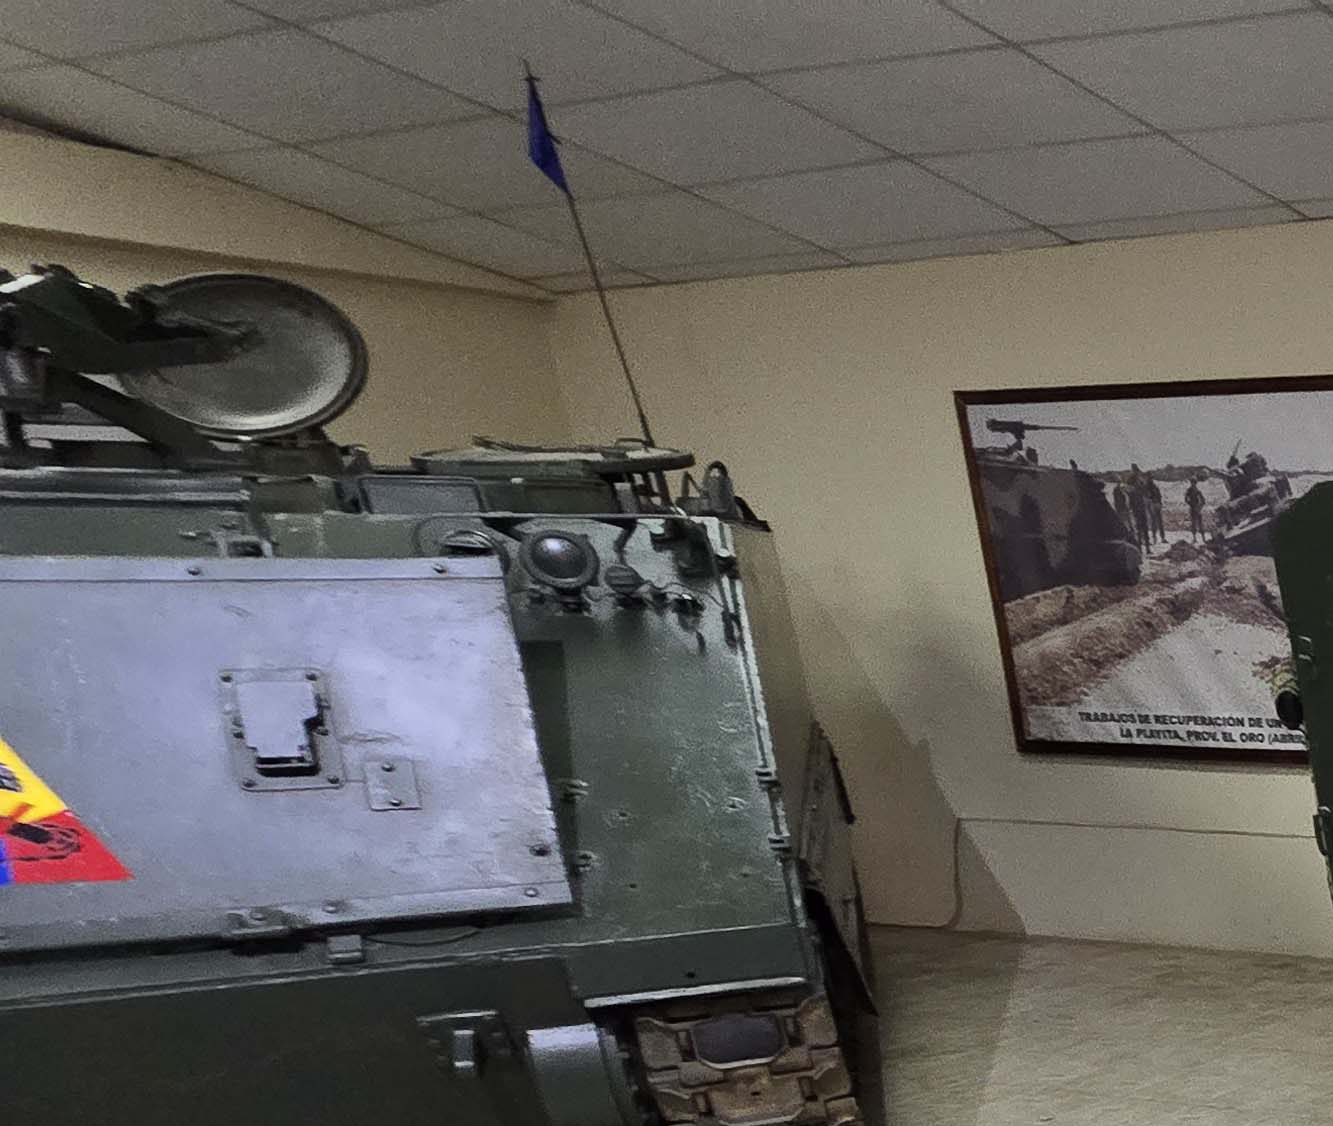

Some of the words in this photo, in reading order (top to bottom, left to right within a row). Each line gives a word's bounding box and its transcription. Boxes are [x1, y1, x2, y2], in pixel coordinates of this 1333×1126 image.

[1078, 711, 1137, 724] TRABAJOS
[1138, 714, 1152, 724] DE
[1248, 717, 1264, 728] DE
[1120, 727, 1133, 738] LA
[1221, 732, 1237, 743] EL
[1239, 733, 1265, 744] ORO
